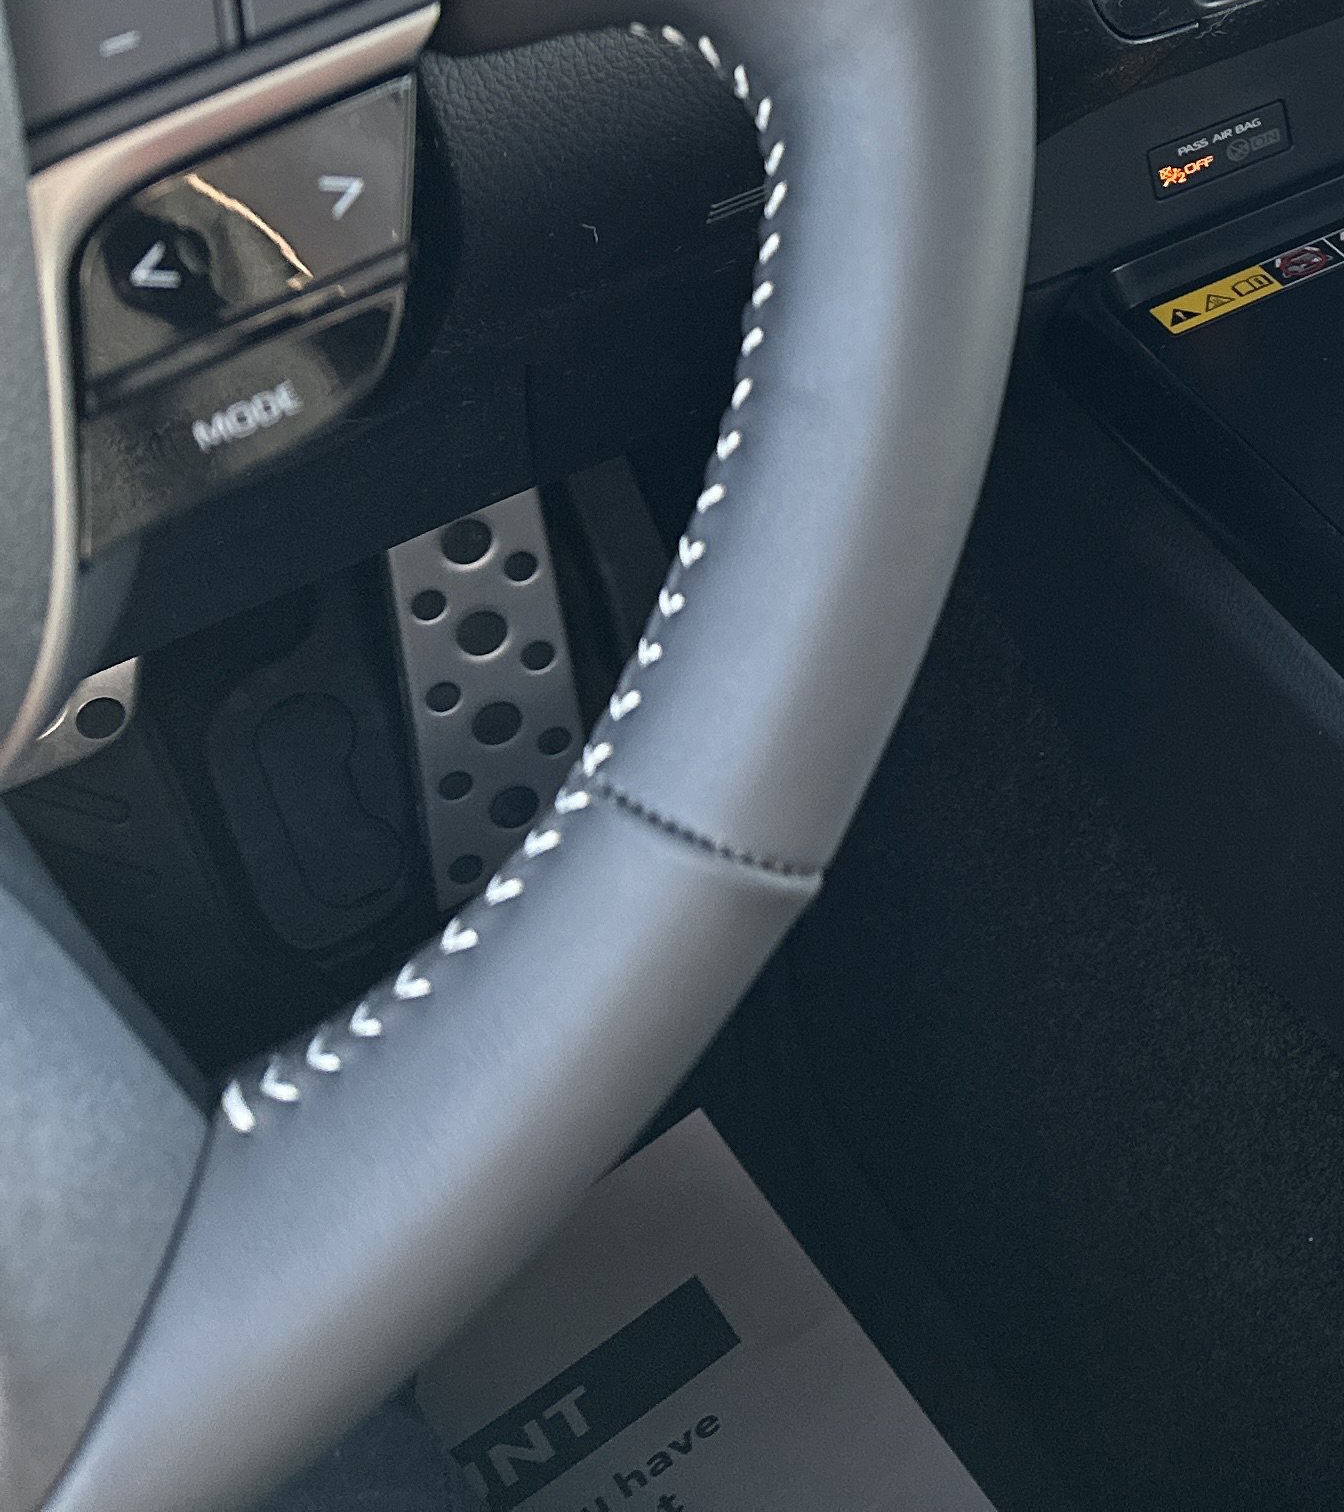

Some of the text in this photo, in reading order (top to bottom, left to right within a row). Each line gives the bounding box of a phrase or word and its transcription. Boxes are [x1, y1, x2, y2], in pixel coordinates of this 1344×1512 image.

[1177, 117, 1262, 157] PASS AIR BAG
[1184, 155, 1214, 175] OFF
[191, 378, 304, 455] MODE
[612, 1413, 722, 1500] have
